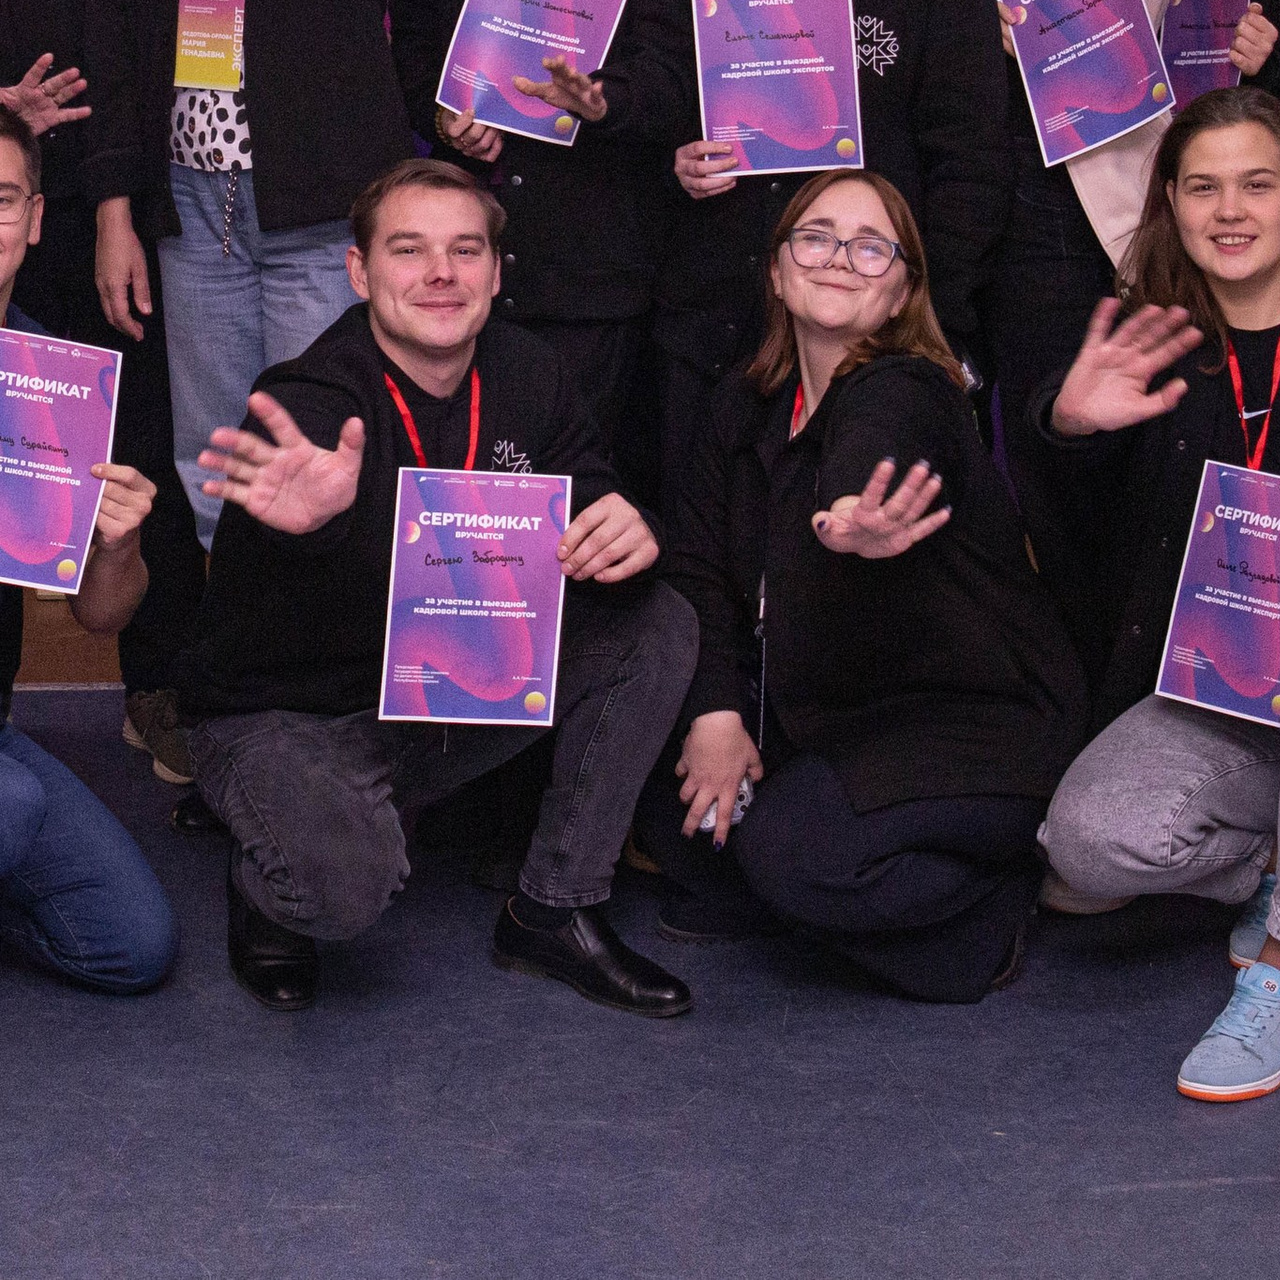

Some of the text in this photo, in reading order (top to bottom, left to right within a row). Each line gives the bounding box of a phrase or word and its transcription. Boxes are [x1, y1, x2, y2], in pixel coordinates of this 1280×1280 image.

[232, 7, 245, 71] ЭКСПЕРТ
[481, 21, 585, 54] кадровой школе экспертов
[502, 19, 534, 33] участие
[541, 31, 580, 44] выездной
[1057, 41, 1085, 59] участие
[1092, 19, 1124, 41] выездной
[1042, 23, 1134, 73] кадровой школе экспертов
[741, 61, 775, 69] участие
[783, 56, 824, 65] выездной
[721, 69, 762, 79] кадровой
[6, 390, 53, 404] ВРУЧАЕТСЯ
[28, 461, 72, 474] выездной
[4, 467, 34, 477] школе
[35, 473, 81, 486] экспертов
[419, 511, 542, 530] СЕРТИФИКАТ
[1215, 505, 1280, 531] СЕРТИФИ
[455, 531, 504, 540] ВРУЧАЕТСЯ
[1240, 527, 1278, 541] ВРУЧАЕТСЯ
[424, 550, 525, 567] Сергею Забродину
[1214, 587, 1241, 600] участие
[482, 600, 527, 608] выездной
[1195, 593, 1280, 620] кадровой школе эксперт
[414, 607, 458, 615] кадровой
[491, 611, 536, 619] экспертов
[1264, 980, 1277, 992] 58
